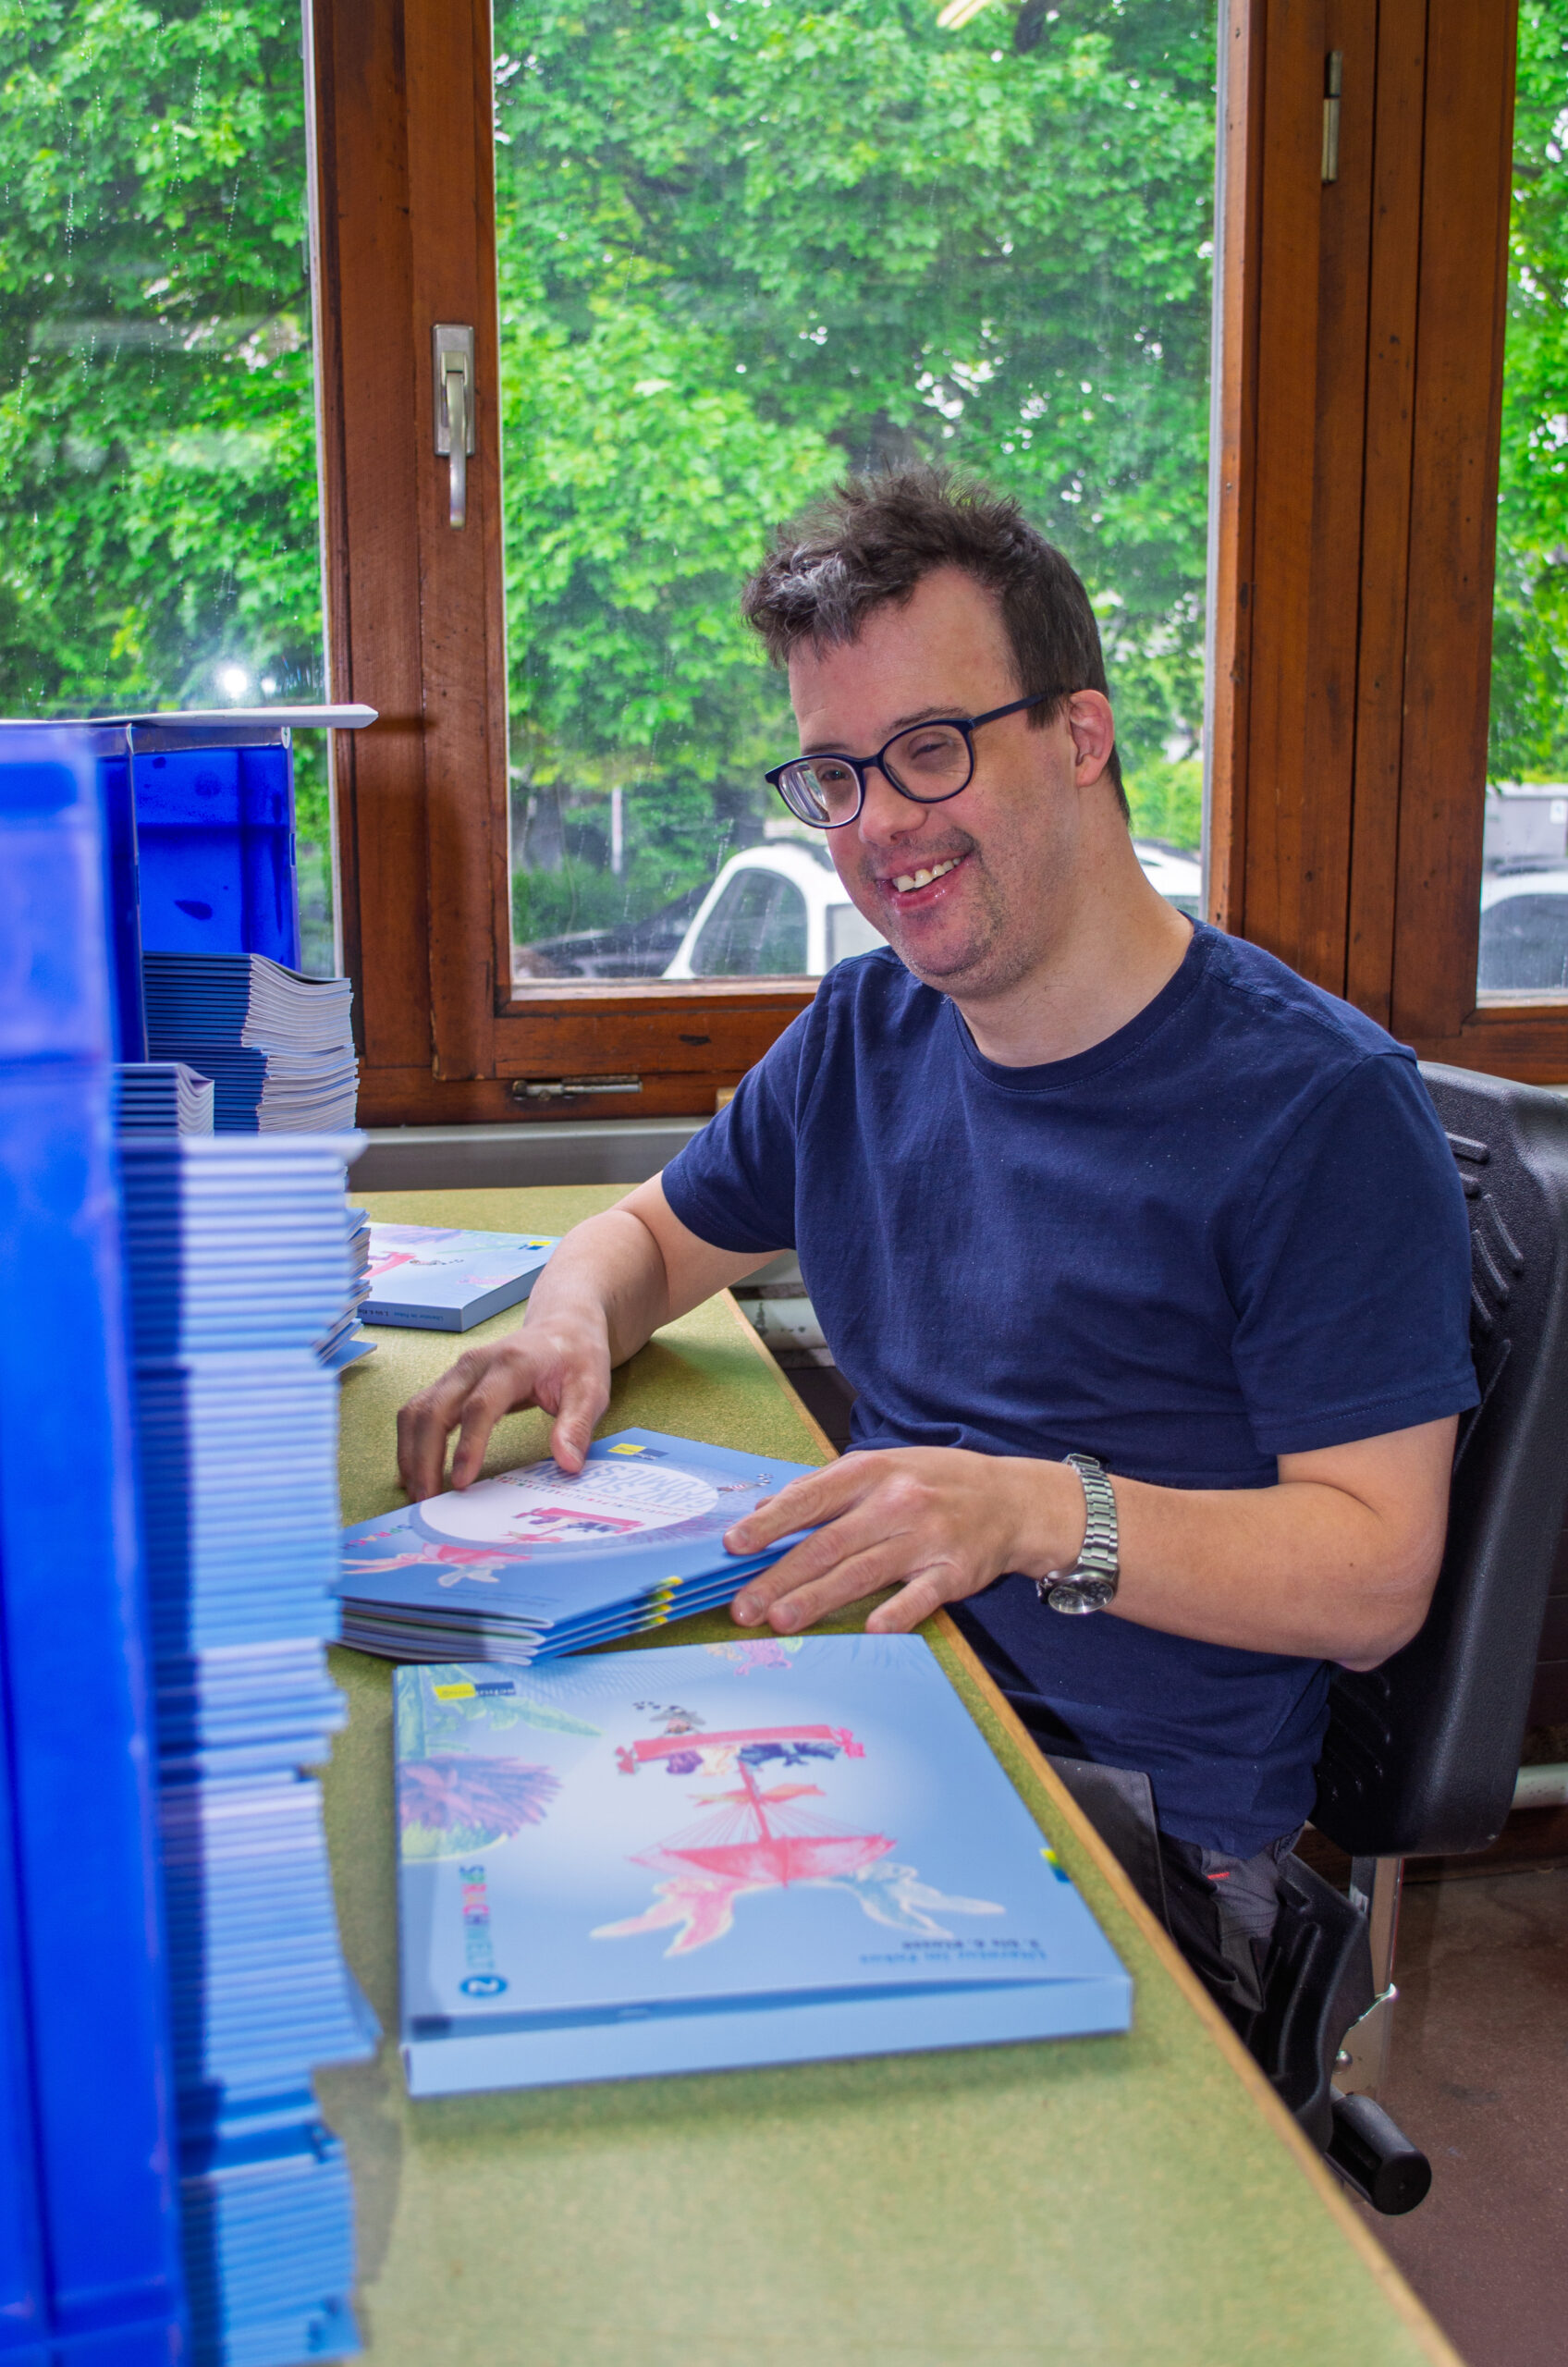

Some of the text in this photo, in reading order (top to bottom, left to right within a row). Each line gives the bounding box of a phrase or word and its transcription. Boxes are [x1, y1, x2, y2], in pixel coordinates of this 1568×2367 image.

[626, 1488, 717, 1509] GANZ
[338, 1524, 414, 1551] SPRACH
[459, 1865, 495, 1969] SPRACHWELT
